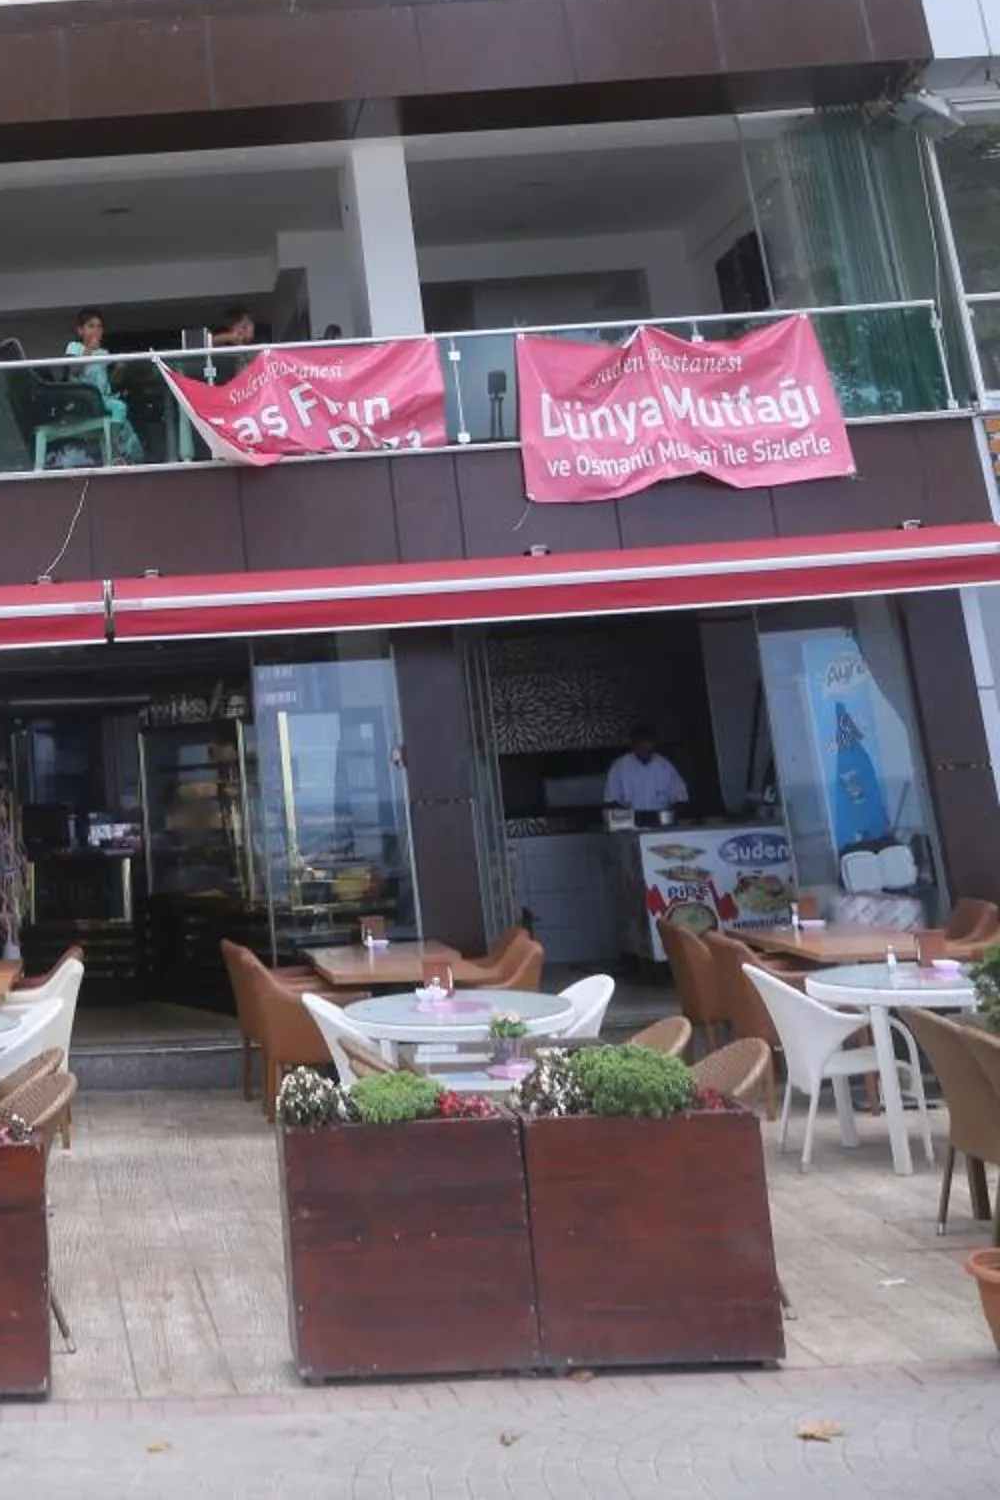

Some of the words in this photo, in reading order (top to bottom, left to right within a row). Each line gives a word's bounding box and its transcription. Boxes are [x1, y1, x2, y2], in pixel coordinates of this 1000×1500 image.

[663, 377, 821, 428] Mutfağı
[546, 458, 571, 477] ve
[576, 447, 656, 476] Osmanlı
[723, 442, 748, 466] ile
[752, 434, 831, 463] Sizlerle
[726, 841, 790, 861] Suden
